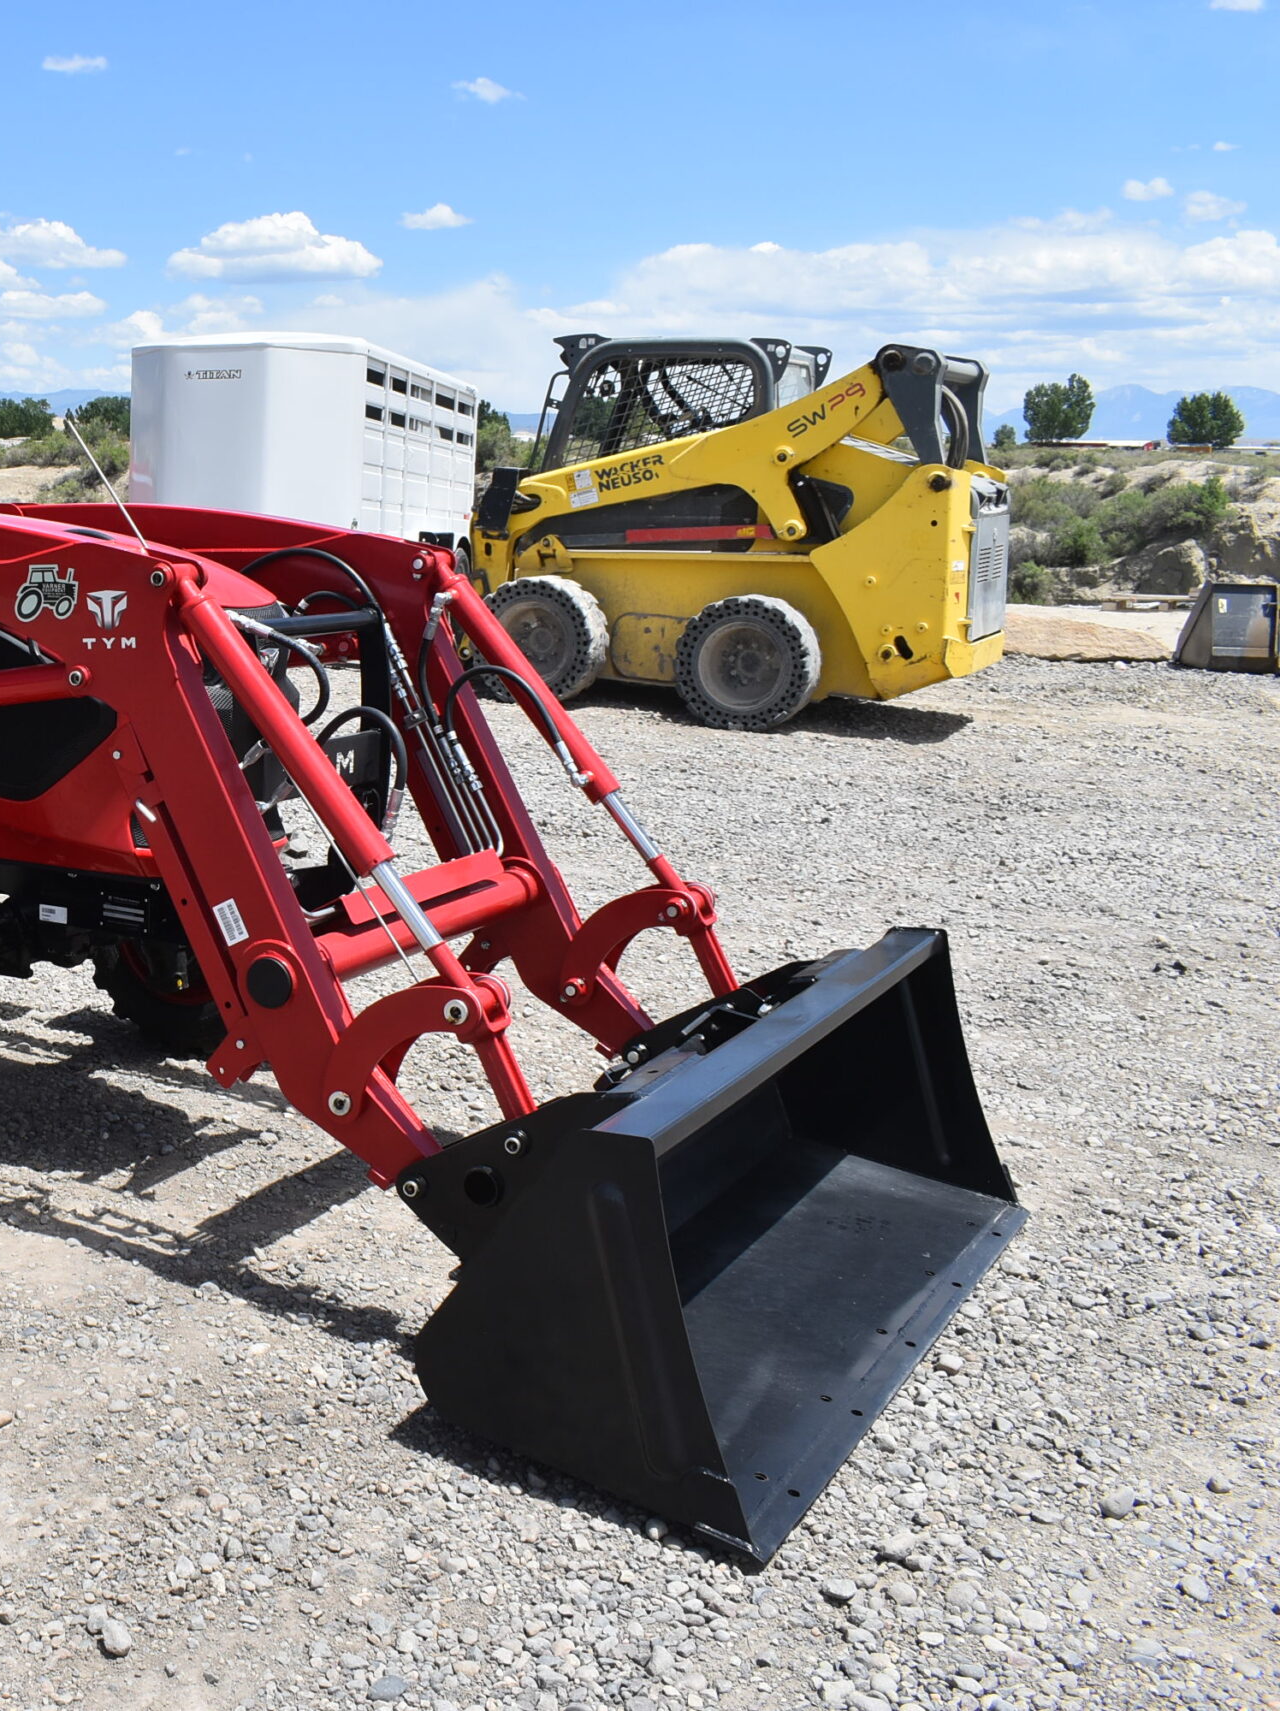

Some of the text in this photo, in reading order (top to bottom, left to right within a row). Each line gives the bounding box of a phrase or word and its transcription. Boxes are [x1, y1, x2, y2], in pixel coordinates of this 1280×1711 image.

[196, 369, 242, 380] TITAN
[598, 469, 660, 493] NEUSO
[82, 637, 137, 650] TYM
